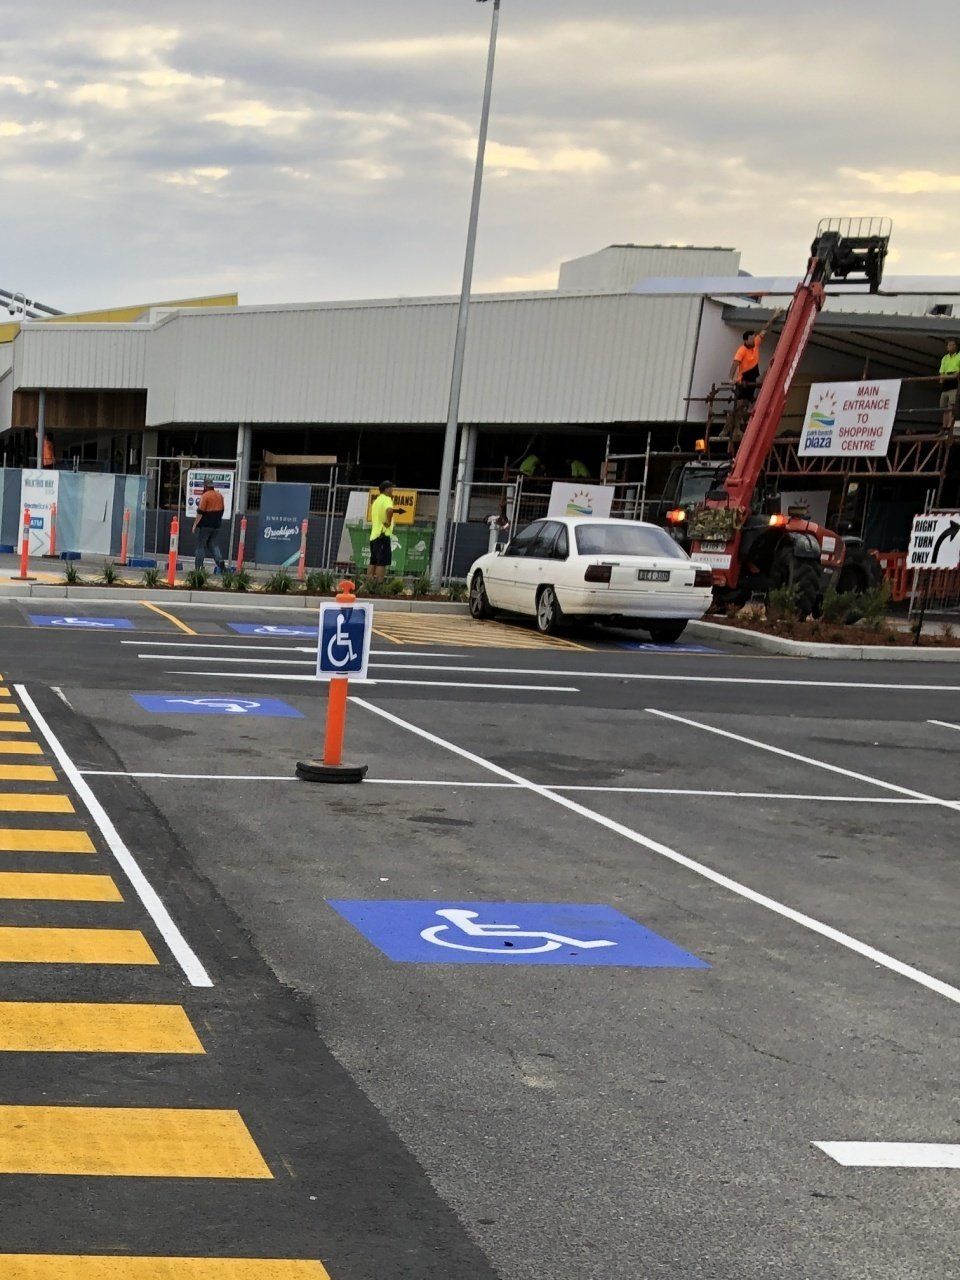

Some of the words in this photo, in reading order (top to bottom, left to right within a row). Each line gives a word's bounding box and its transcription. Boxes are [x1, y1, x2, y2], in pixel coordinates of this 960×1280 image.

[857, 386, 880, 396] MAIN
[843, 399, 890, 410] ENTRANCE
[857, 413, 869, 424] TO
[839, 426, 884, 438] SHOPPING
[805, 437, 832, 450] plaza
[841, 440, 876, 451] CENTRE
[914, 519, 938, 532] RIGHT
[913, 535, 934, 548] TURN
[911, 551, 930, 564] ONLY
